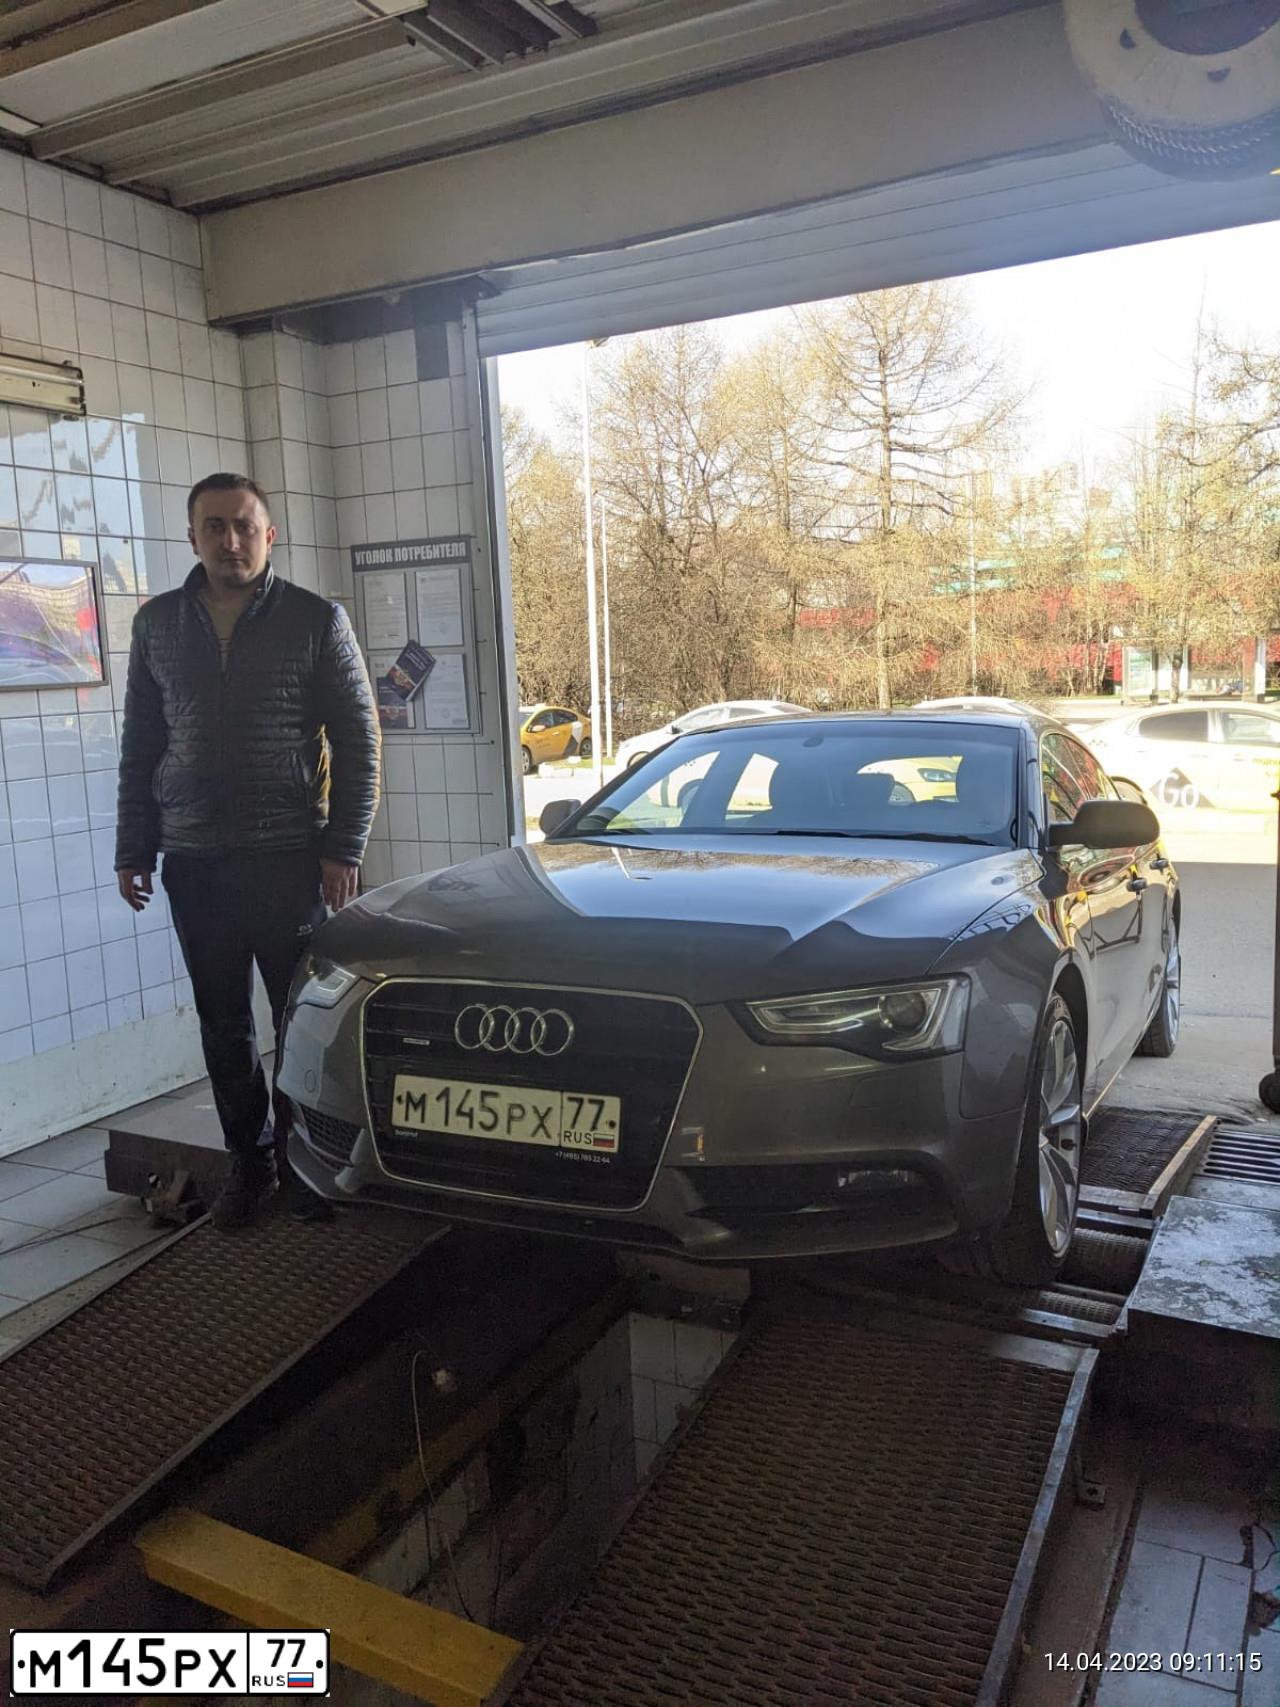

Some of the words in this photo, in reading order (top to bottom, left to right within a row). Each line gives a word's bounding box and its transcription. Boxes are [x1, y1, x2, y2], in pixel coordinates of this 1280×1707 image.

[354, 547, 393, 565] УГОЛОК
[394, 541, 466, 562] ПОТРЕБИТЕЛЯ
[1158, 771, 1200, 809] Go
[404, 1086, 553, 1139] М145РХ
[566, 1096, 605, 1132] 77
[563, 1130, 592, 1145] RUS
